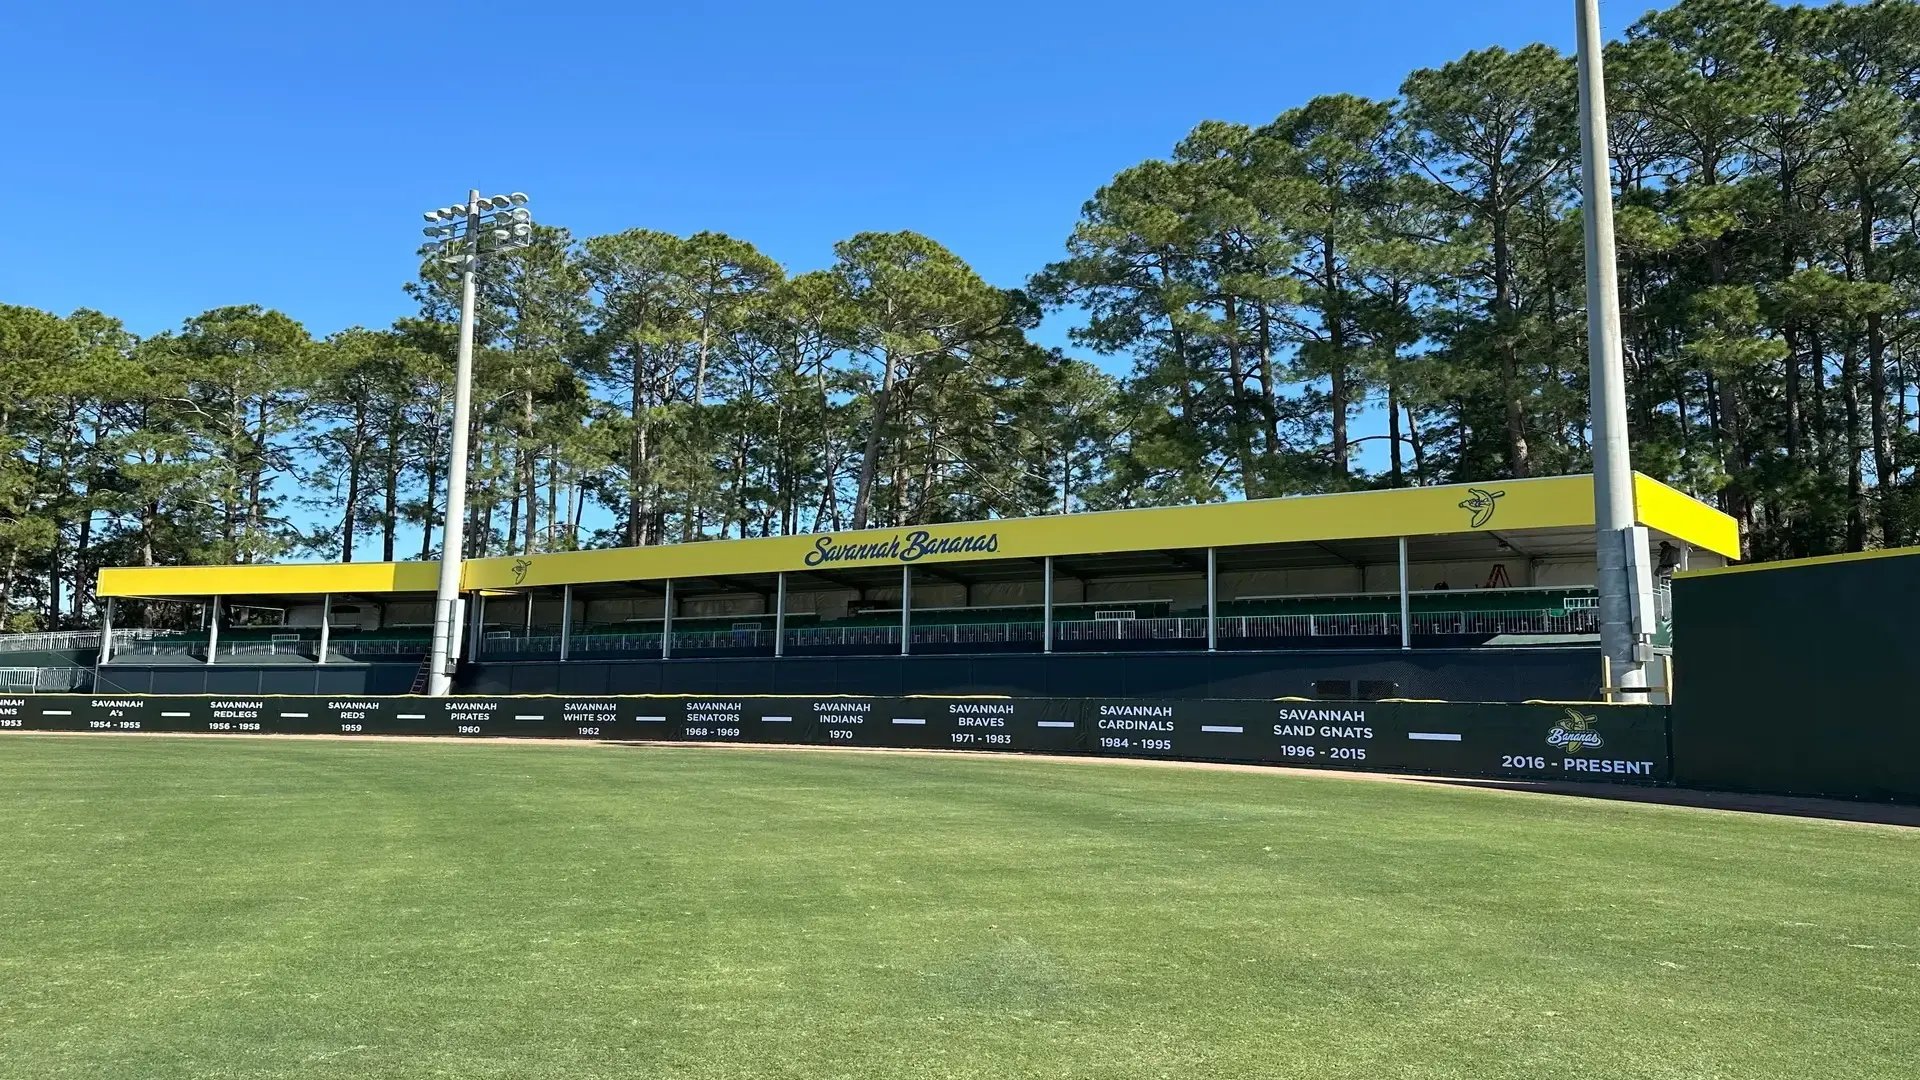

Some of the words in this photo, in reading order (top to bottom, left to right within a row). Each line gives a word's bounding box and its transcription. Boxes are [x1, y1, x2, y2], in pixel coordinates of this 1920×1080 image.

[805, 535, 900, 566] Savannah
[899, 531, 998, 561] Bananas
[91, 700, 144, 708] SAVANNAH
[328, 702, 380, 710] SAVANNAH
[445, 703, 498, 711] SAVANNAH
[564, 703, 617, 711] SAVANNAH
[686, 703, 742, 711] SAVANNAH
[813, 703, 871, 712] SAVANNAH
[949, 705, 1014, 714] SAVANNAH
[1099, 706, 1172, 717] SAVANNAH
[213, 711, 258, 719] REDLEGS
[341, 712, 366, 720] REDS
[451, 713, 490, 721] PIRATES
[563, 714, 593, 722] WHITE
[596, 714, 617, 722] SOX
[686, 714, 740, 722] SENATORS
[819, 715, 864, 724] INDIANS
[1279, 709, 1365, 722] SAVANNAH
[90, 721, 111, 729] 1954
[958, 717, 1005, 727] BRAVES
[1098, 720, 1175, 732] CARDINALS
[341, 724, 363, 732] 1959
[458, 726, 481, 734] 1960
[577, 728, 600, 736] 1962
[685, 728, 708, 736] 1968
[717, 728, 740, 737] 1969
[1273, 725, 1316, 737] SAND
[1319, 726, 1374, 739] GNATS
[828, 730, 853, 739] 1970
[950, 734, 975, 743] 1971
[985, 735, 1011, 744] 1983
[1547, 728, 1602, 747] Bananas
[1100, 738, 1130, 748] 1984
[1141, 739, 1171, 750] 1995
[1281, 745, 1316, 758] 1996
[1330, 748, 1366, 760] 2015
[1502, 755, 1545, 769] 2016
[1564, 758, 1654, 775] PRESENT
